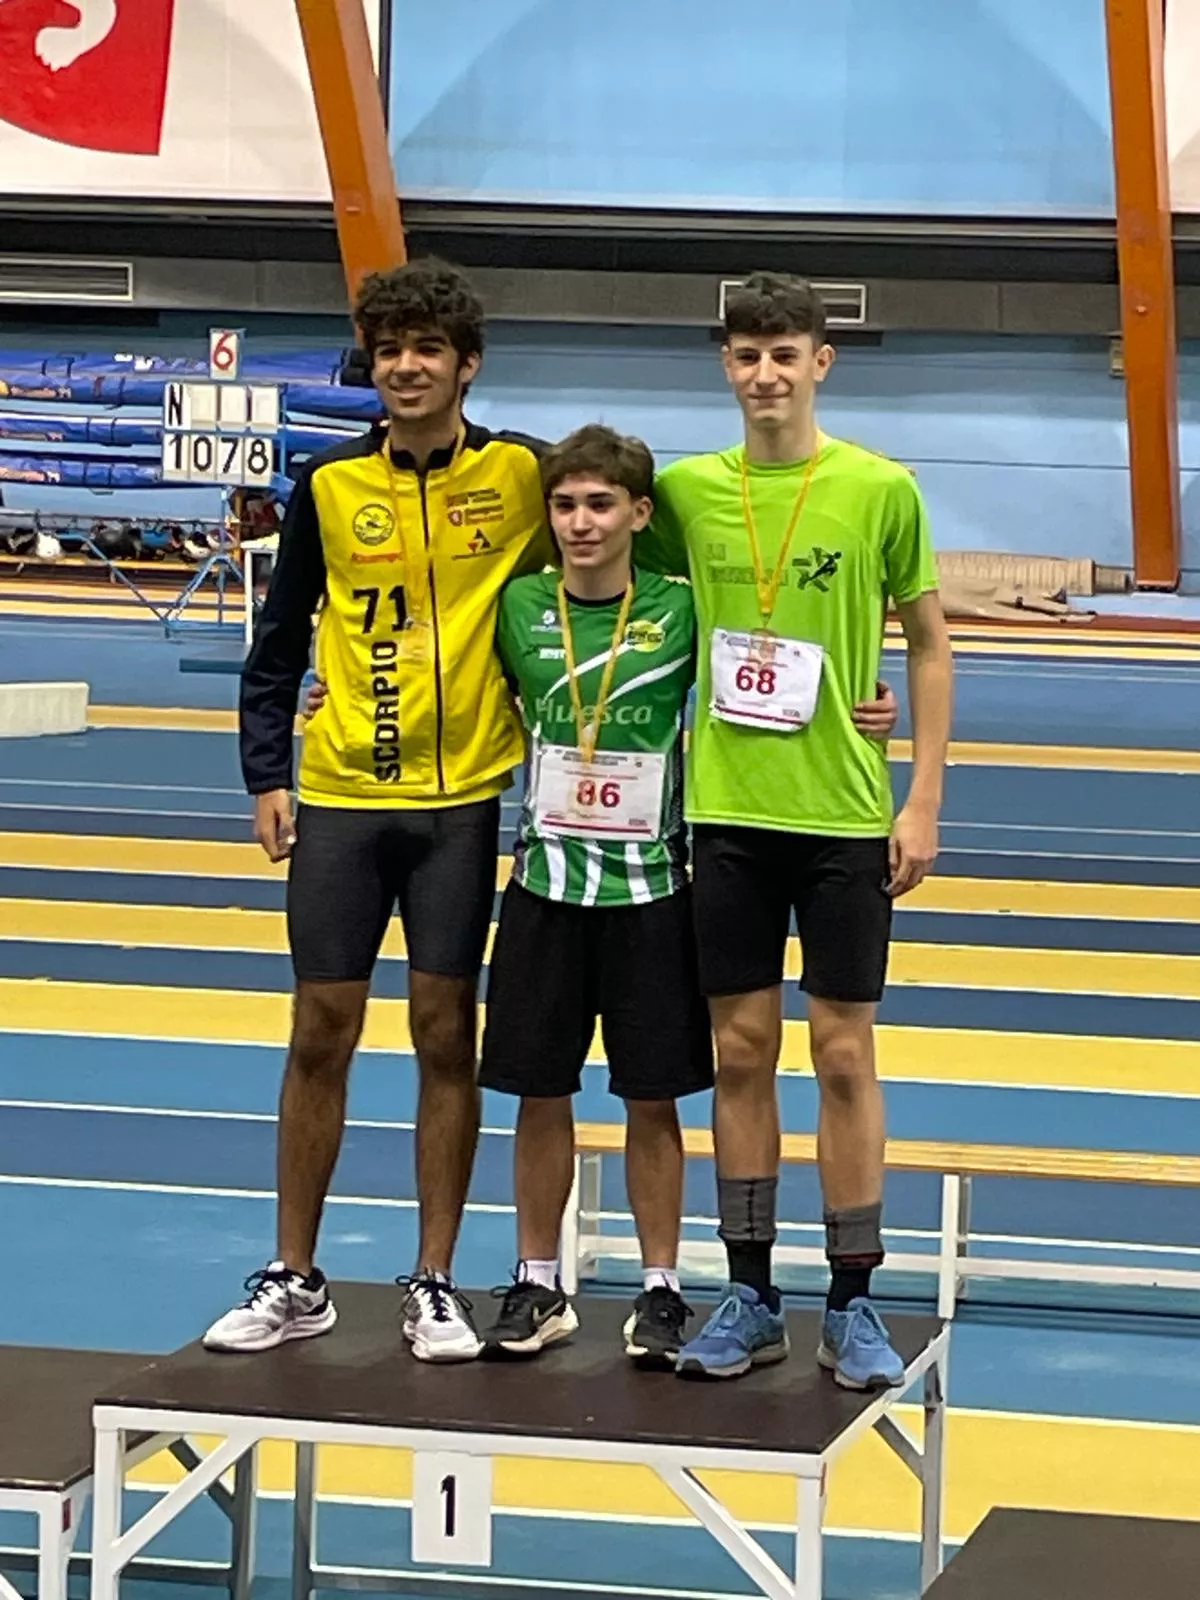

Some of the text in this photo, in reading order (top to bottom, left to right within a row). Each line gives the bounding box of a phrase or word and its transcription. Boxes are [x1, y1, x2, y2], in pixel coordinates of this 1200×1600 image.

[212, 332, 234, 370] 6
[168, 384, 183, 427] N
[169, 433, 269, 475] 1078
[352, 585, 414, 634] 71
[736, 665, 776, 695] 68
[371, 640, 400, 783] SCORPIO
[576, 779, 621, 808] 86
[440, 1474, 456, 1537] 1
